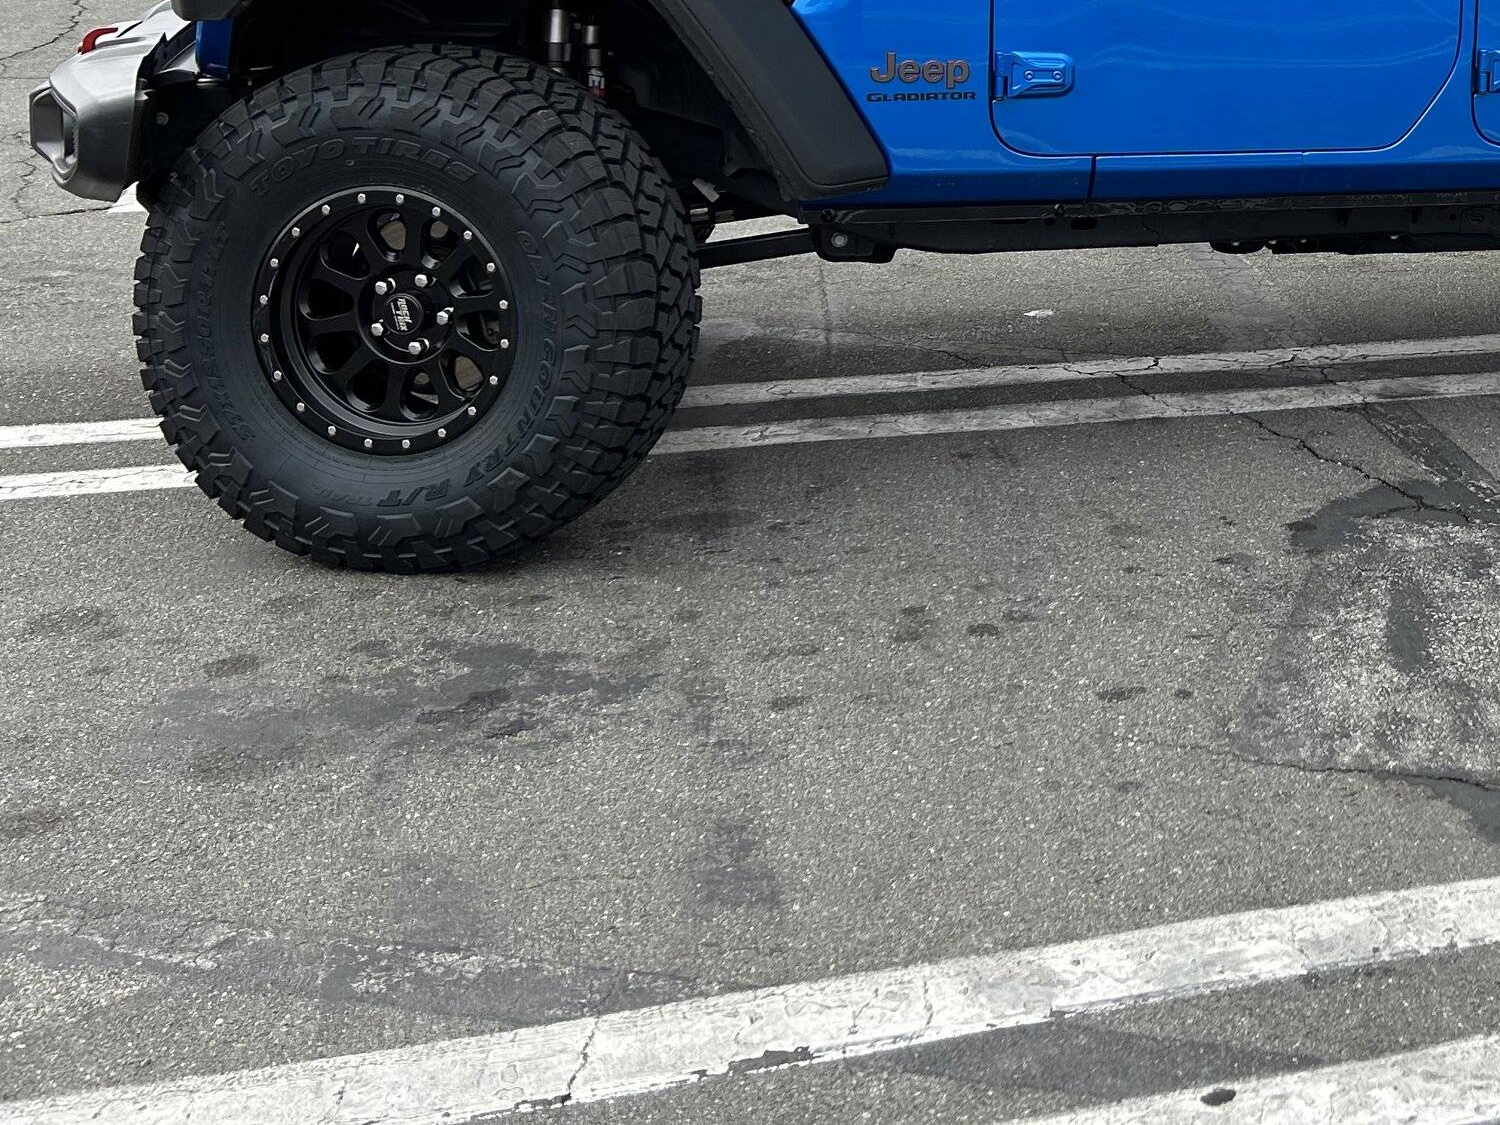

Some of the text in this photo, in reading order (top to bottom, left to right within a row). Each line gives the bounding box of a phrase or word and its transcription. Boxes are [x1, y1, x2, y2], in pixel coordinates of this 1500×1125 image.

[869, 51, 971, 89] Jeep
[866, 91, 977, 102] GLADIATOR
[250, 136, 478, 196] TOYO TIRES
[376, 477, 450, 508] R/T
